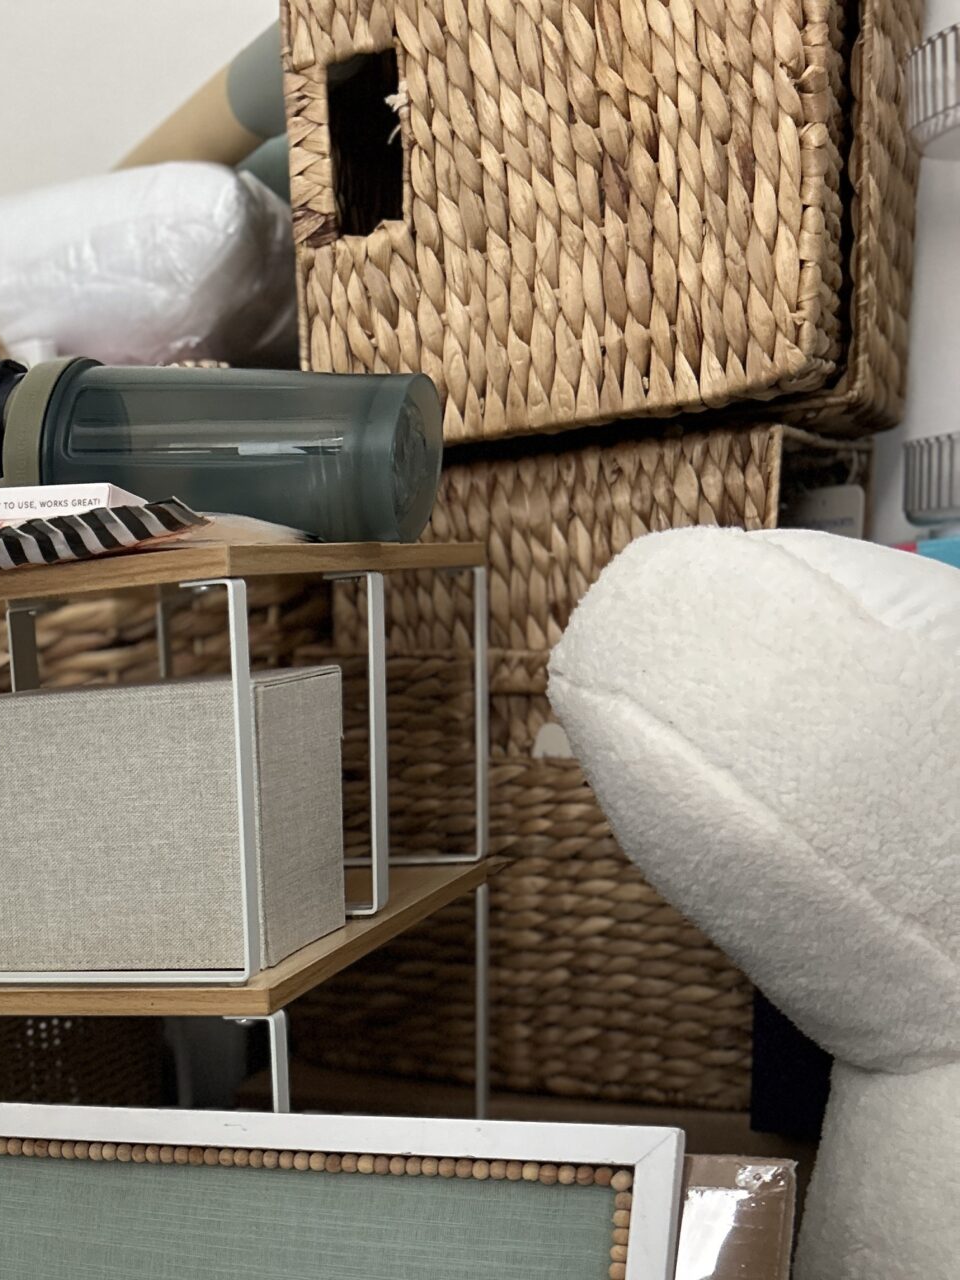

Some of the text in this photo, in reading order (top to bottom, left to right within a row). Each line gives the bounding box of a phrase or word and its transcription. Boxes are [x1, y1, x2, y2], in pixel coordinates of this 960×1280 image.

[3, 501, 15, 510] TO
[17, 500, 37, 510] USE,
[39, 499, 69, 508] WORKS
[70, 497, 101, 507] GREAT!
